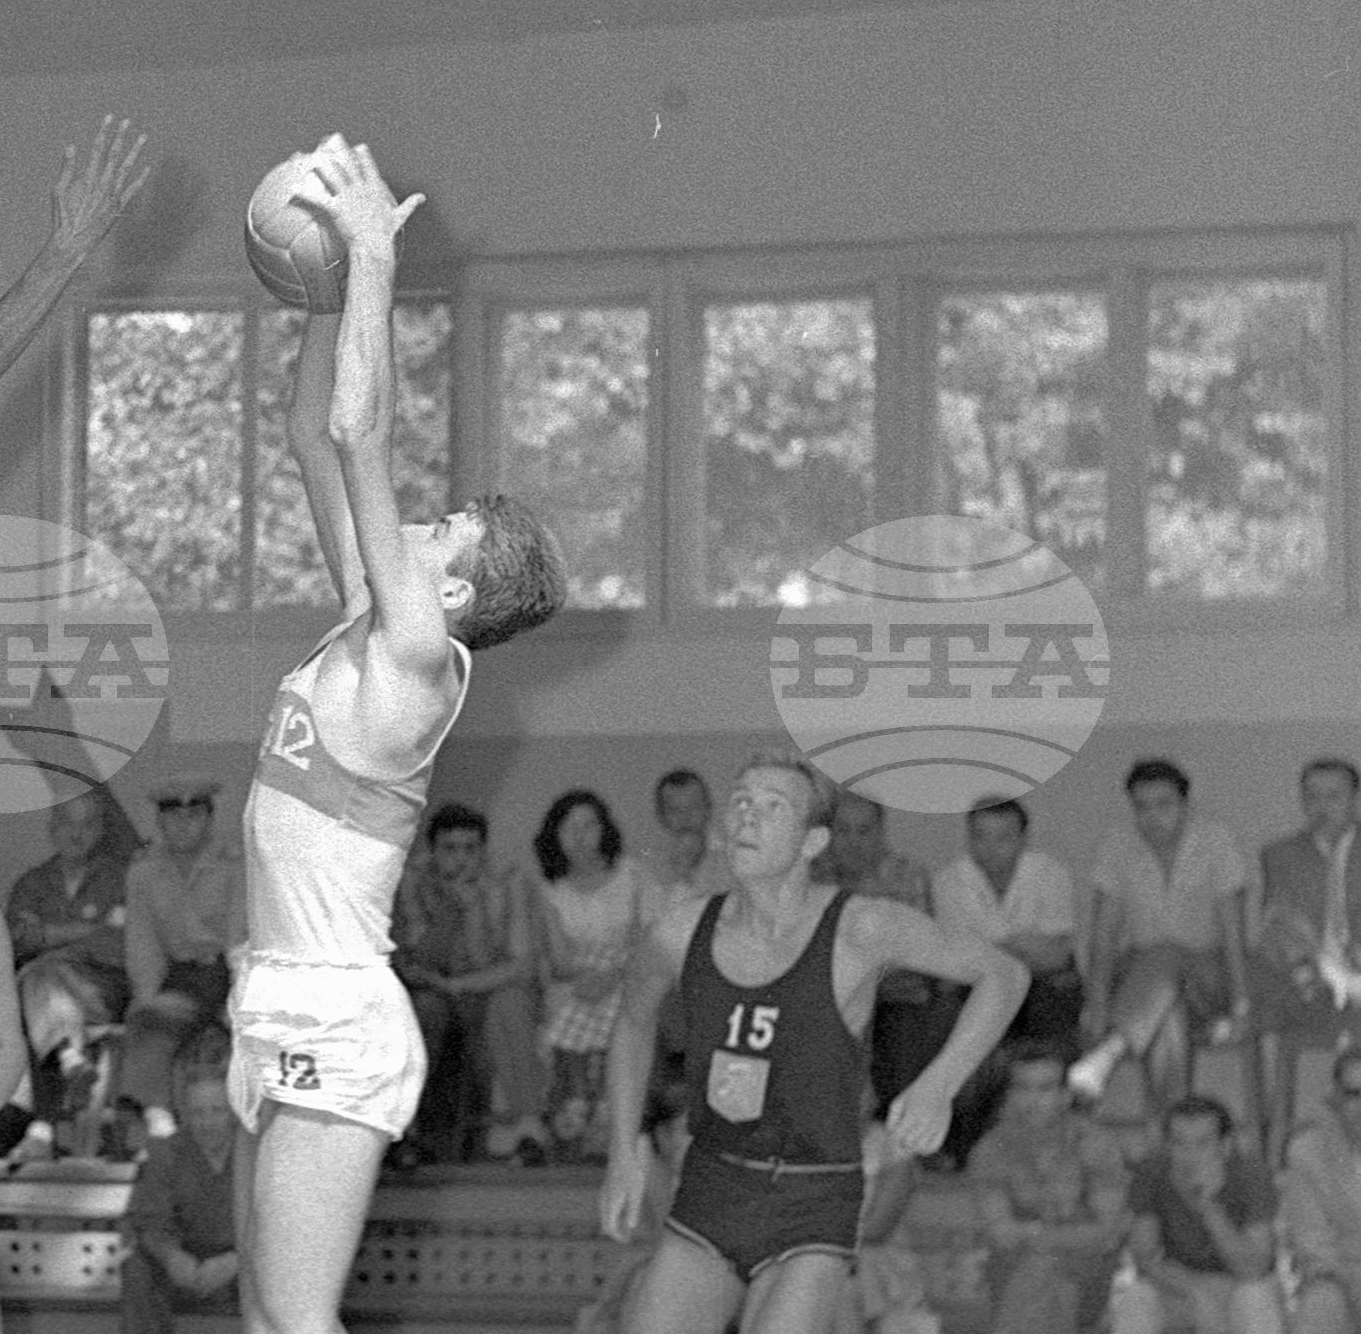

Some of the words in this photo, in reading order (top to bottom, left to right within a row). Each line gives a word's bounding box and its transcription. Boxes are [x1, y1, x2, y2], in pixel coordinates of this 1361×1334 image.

[271, 705, 315, 770] 12
[725, 1003, 780, 1051] 15
[278, 1051, 321, 1090] 12
